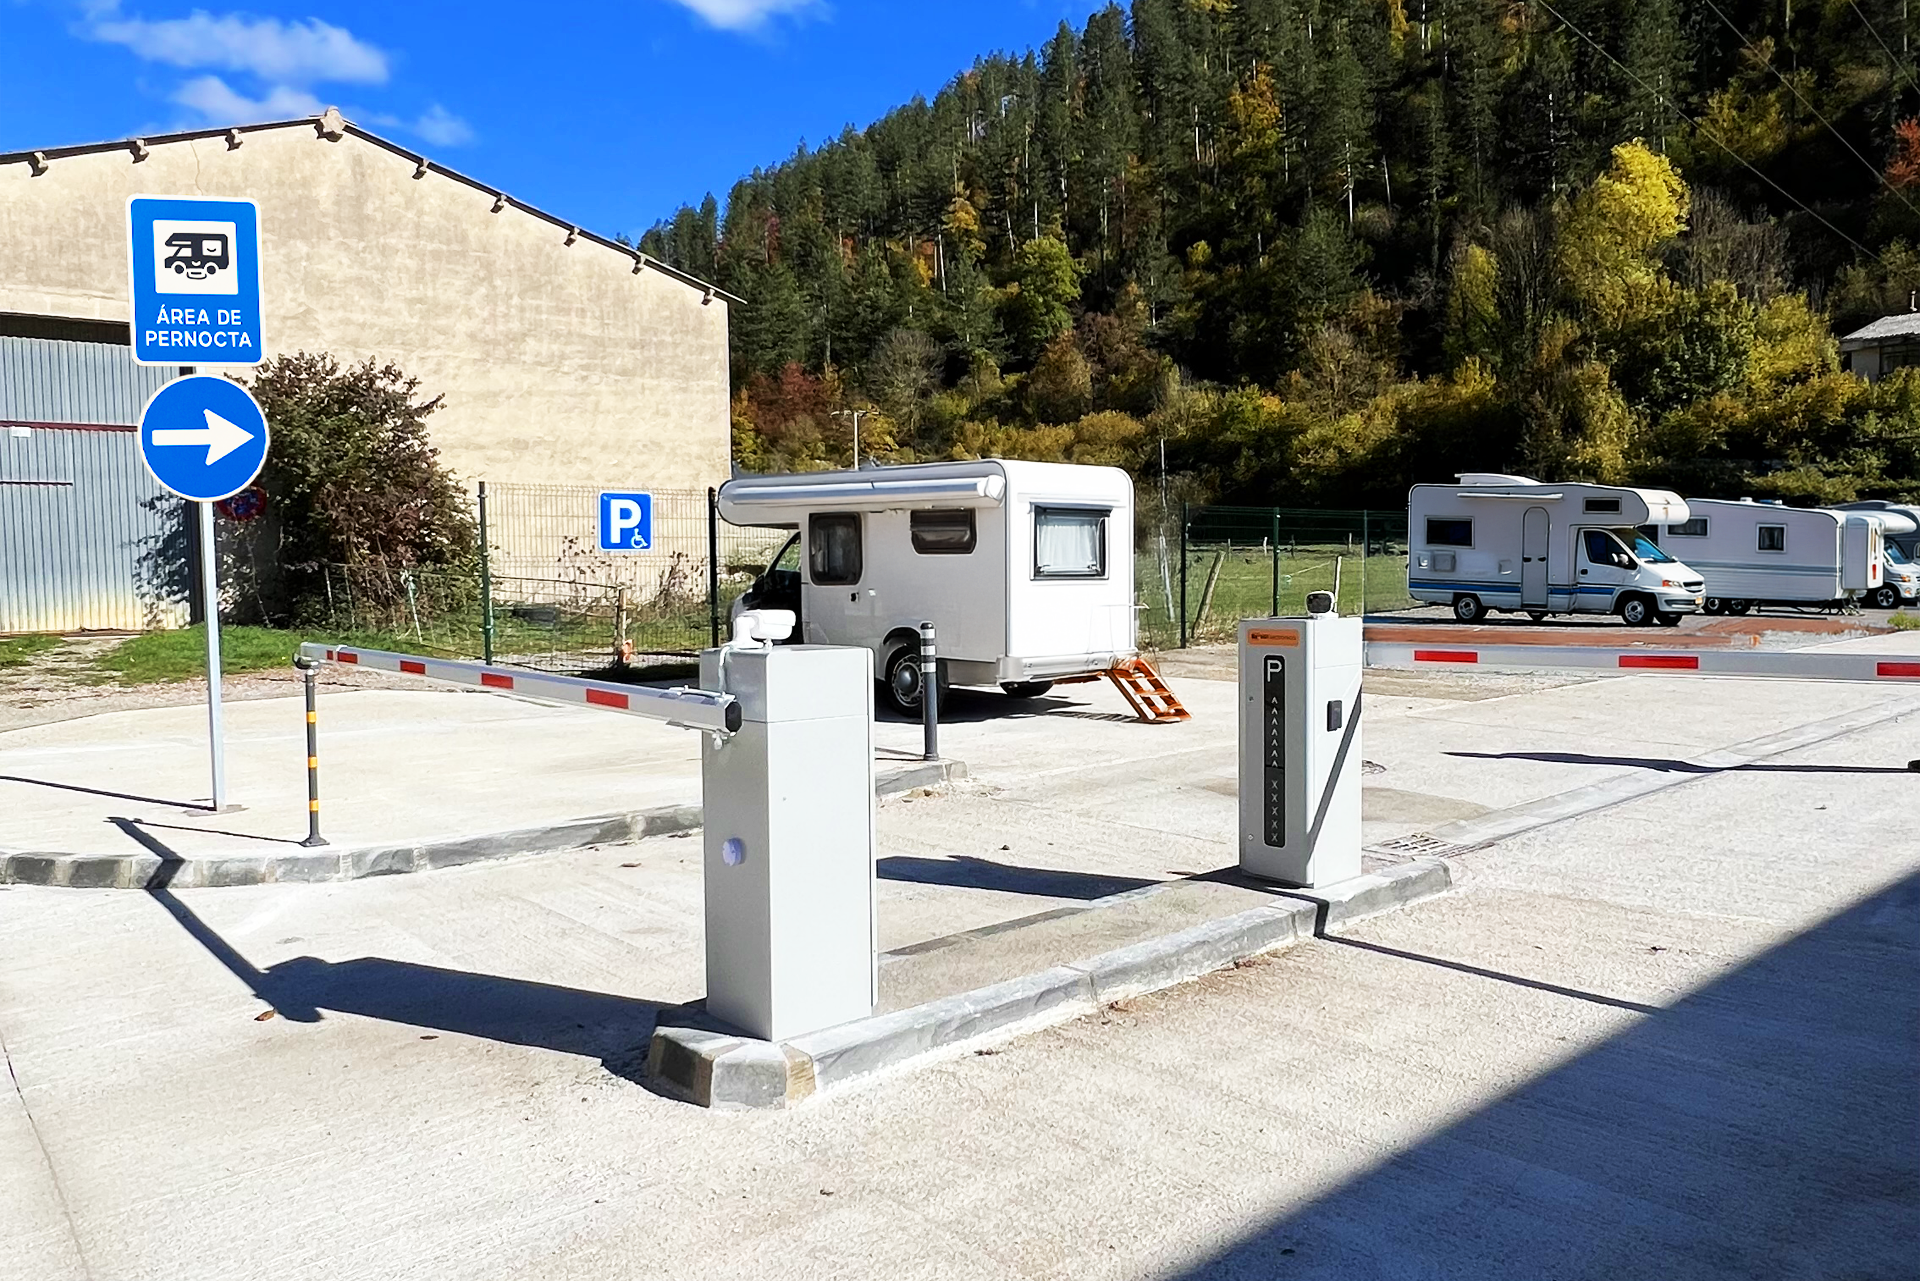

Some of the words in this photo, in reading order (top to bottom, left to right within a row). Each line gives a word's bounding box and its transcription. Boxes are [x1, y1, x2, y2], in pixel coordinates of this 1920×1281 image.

[156, 303, 211, 325] ÁREA
[217, 309, 242, 326] DE
[145, 330, 252, 348] PERNOCTA
[610, 498, 642, 544] P
[1267, 659, 1282, 682] P
